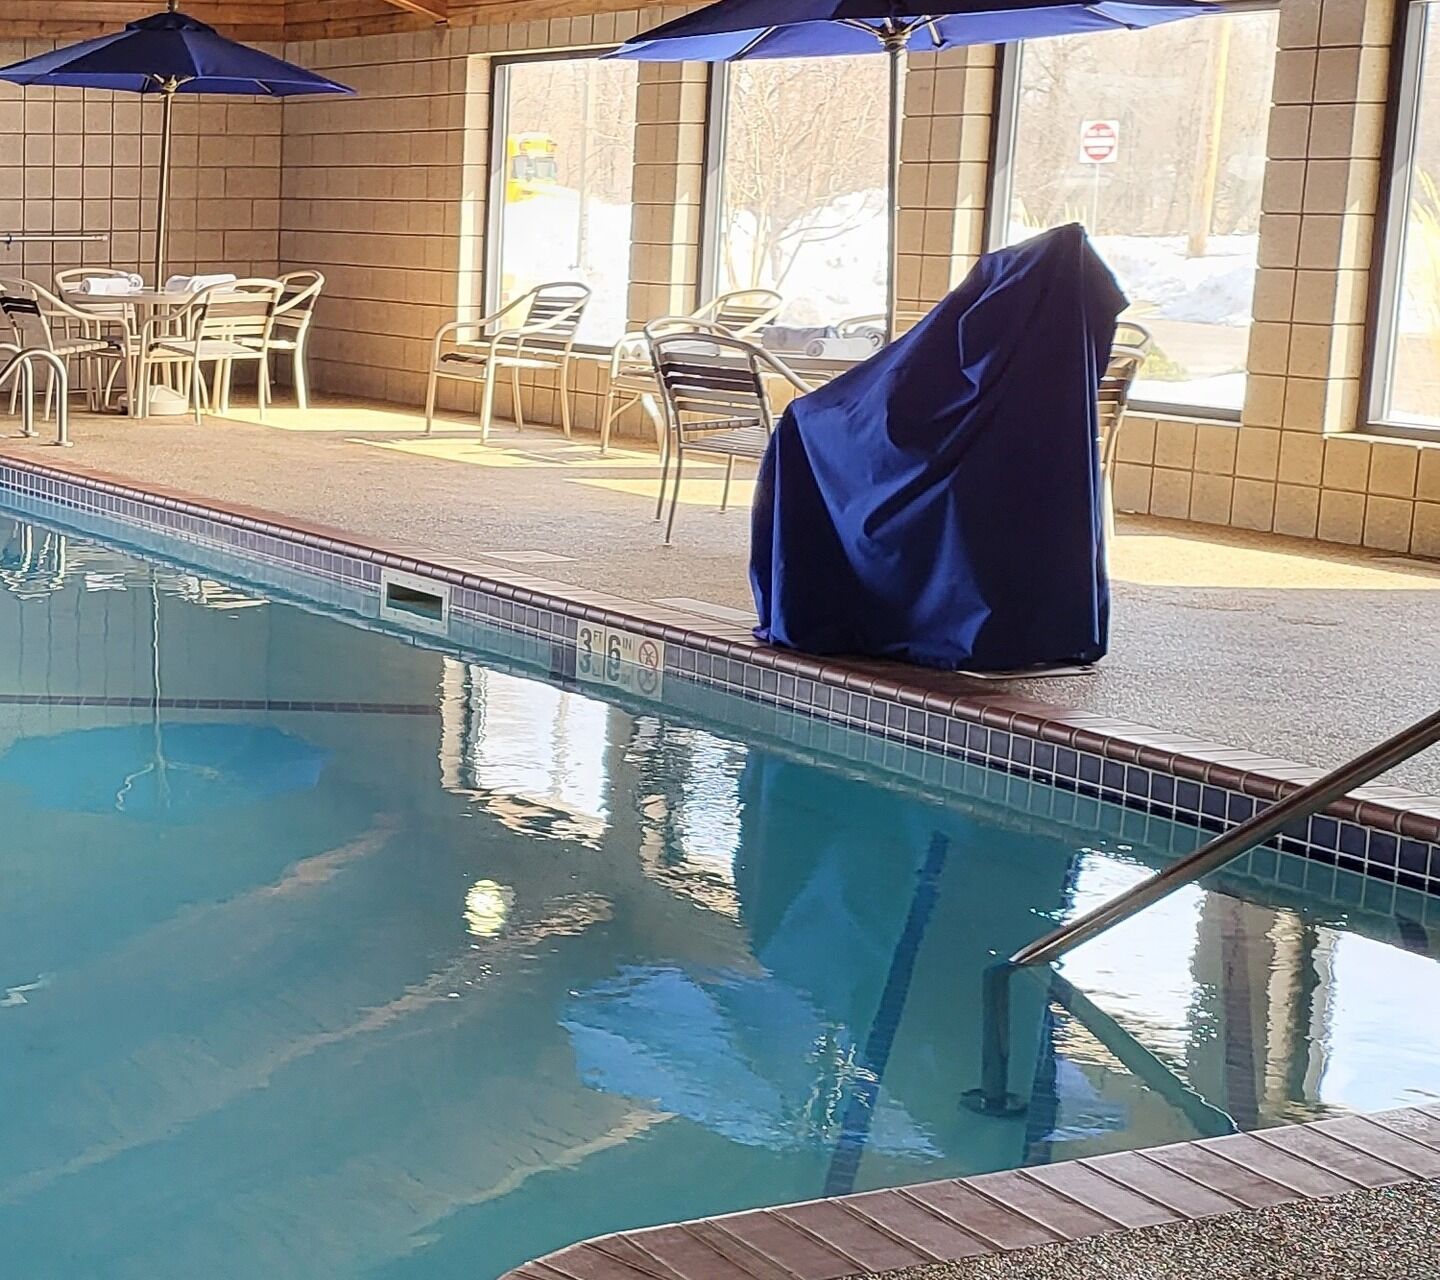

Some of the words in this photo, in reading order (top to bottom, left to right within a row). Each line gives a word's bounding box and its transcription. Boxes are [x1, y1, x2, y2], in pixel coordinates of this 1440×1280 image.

[580, 628, 591, 652] 3
[594, 631, 602, 643] FT
[609, 635, 621, 660] 6
[623, 637, 631, 650] IN
